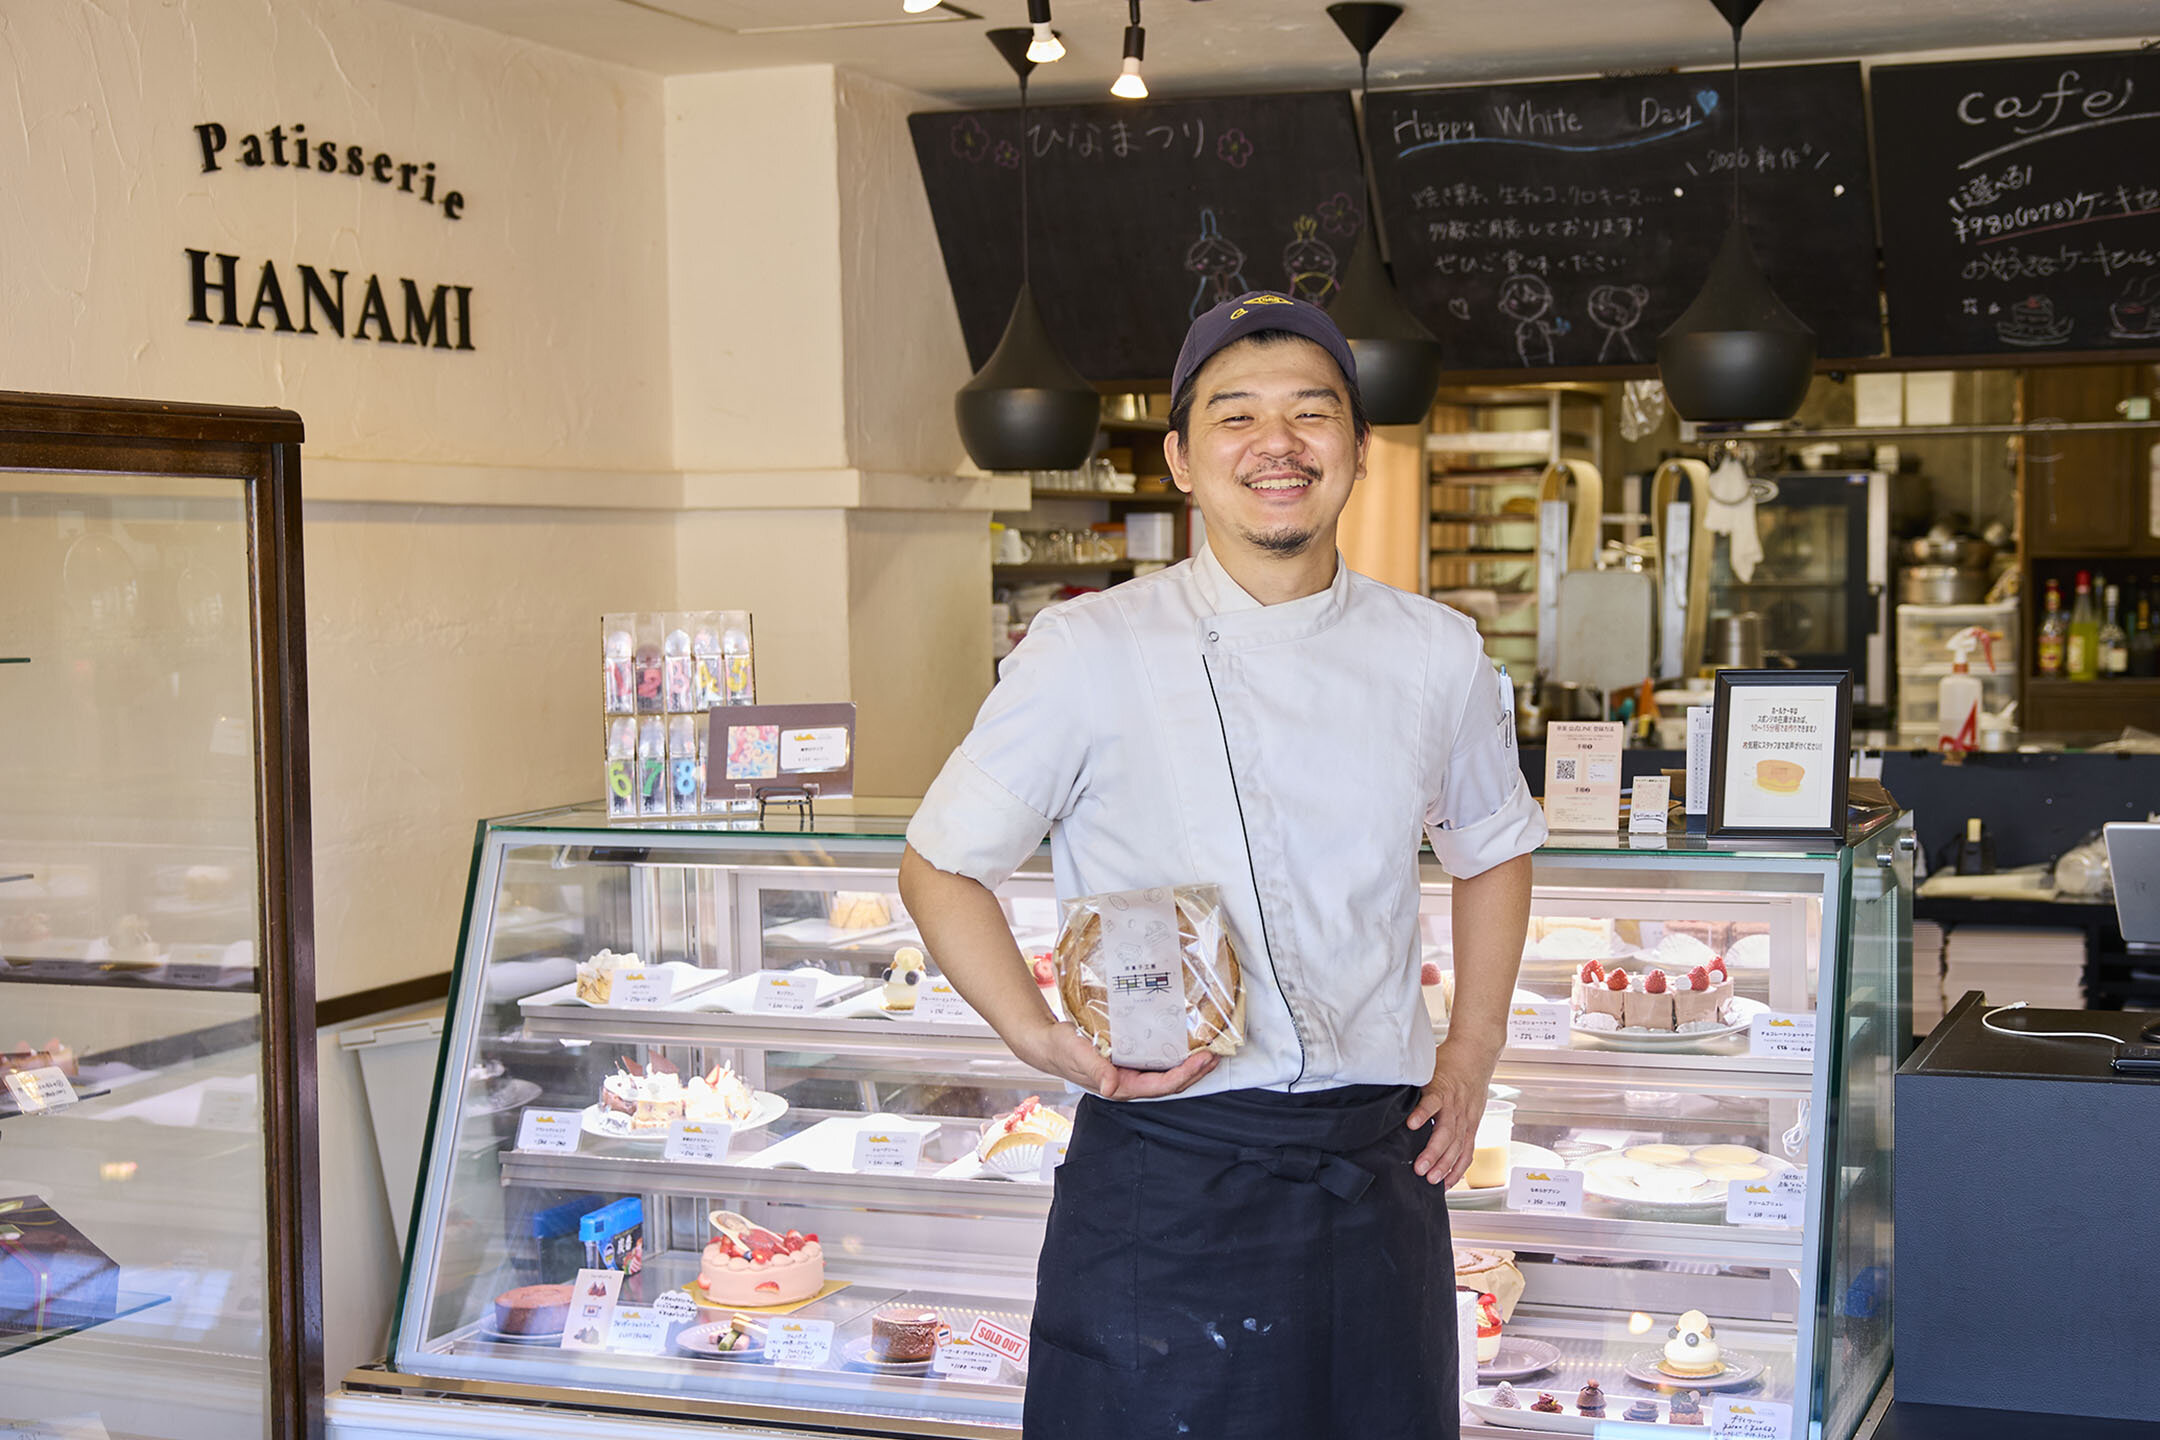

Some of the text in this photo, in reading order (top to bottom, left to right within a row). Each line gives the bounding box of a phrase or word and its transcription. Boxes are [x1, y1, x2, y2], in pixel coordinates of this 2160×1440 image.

[1027, 119, 1204, 157] ひなまつり
[1394, 97, 1692, 144] Happy White Day
[194, 123, 465, 220] Patisserie
[184, 248, 476, 351] HANAMI
[978, 1326, 1022, 1354] SOLD OUT
